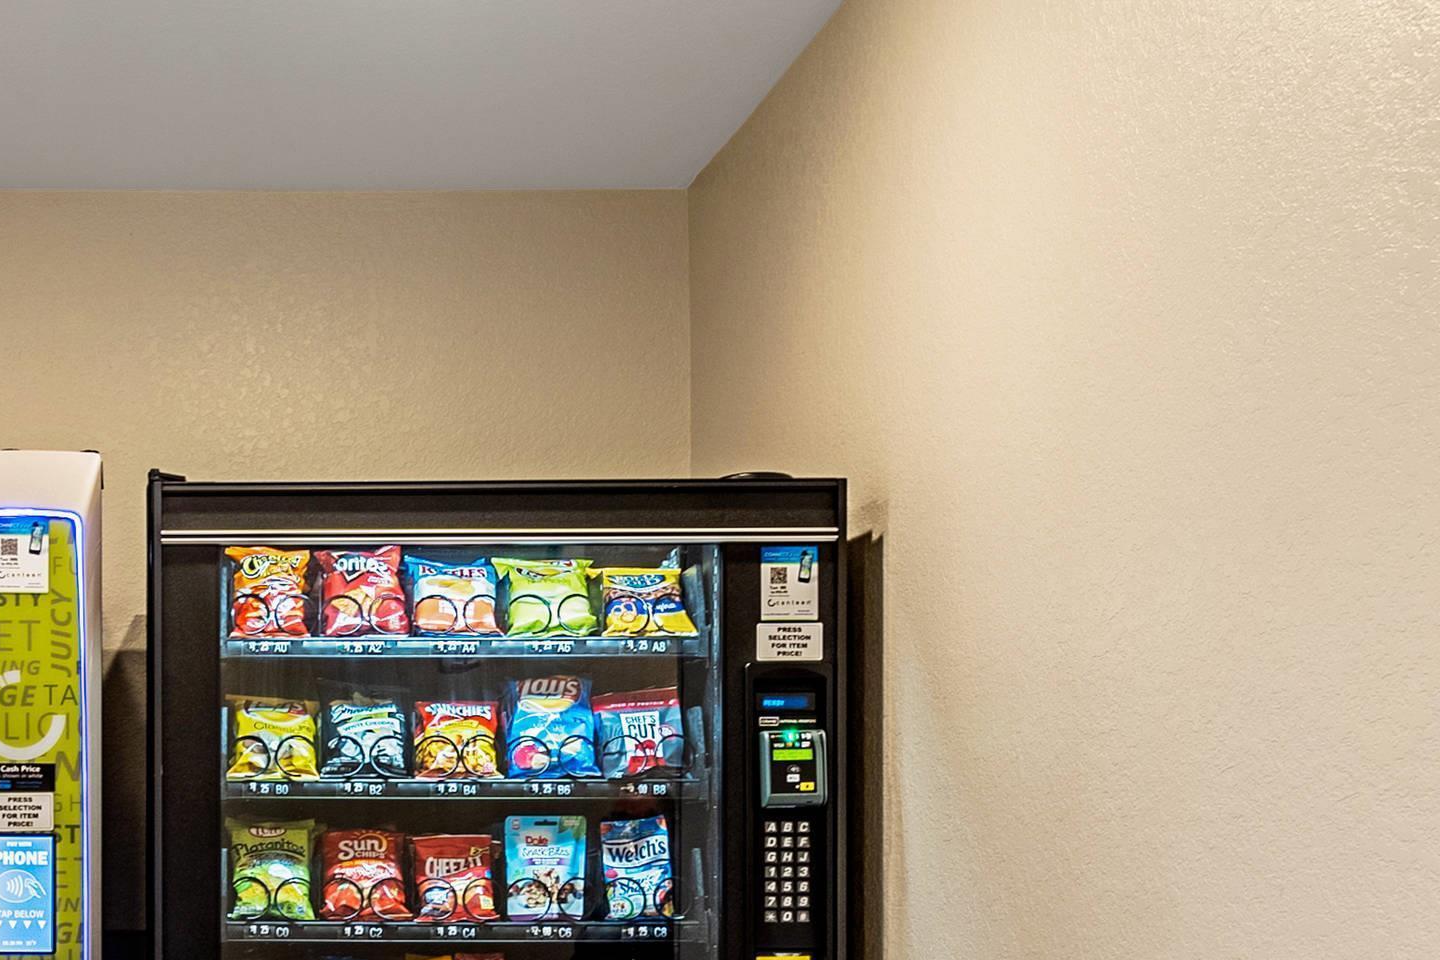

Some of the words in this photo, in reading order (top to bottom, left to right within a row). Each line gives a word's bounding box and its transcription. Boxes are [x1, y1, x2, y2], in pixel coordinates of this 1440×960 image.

[652, 641, 666, 652] A8
[627, 723, 657, 739] CUT
[0, 765, 19, 773] Cash
[21, 765, 41, 773] Price
[369, 784, 383, 795] B2
[463, 784, 477, 795] B4
[525, 836, 549, 847] Dole
[338, 838, 382, 860] Sun
[606, 838, 667, 863] Welch's
[15, 910, 45, 918] BELOW
[369, 927, 383, 938] C2
[462, 927, 476, 938] C4
